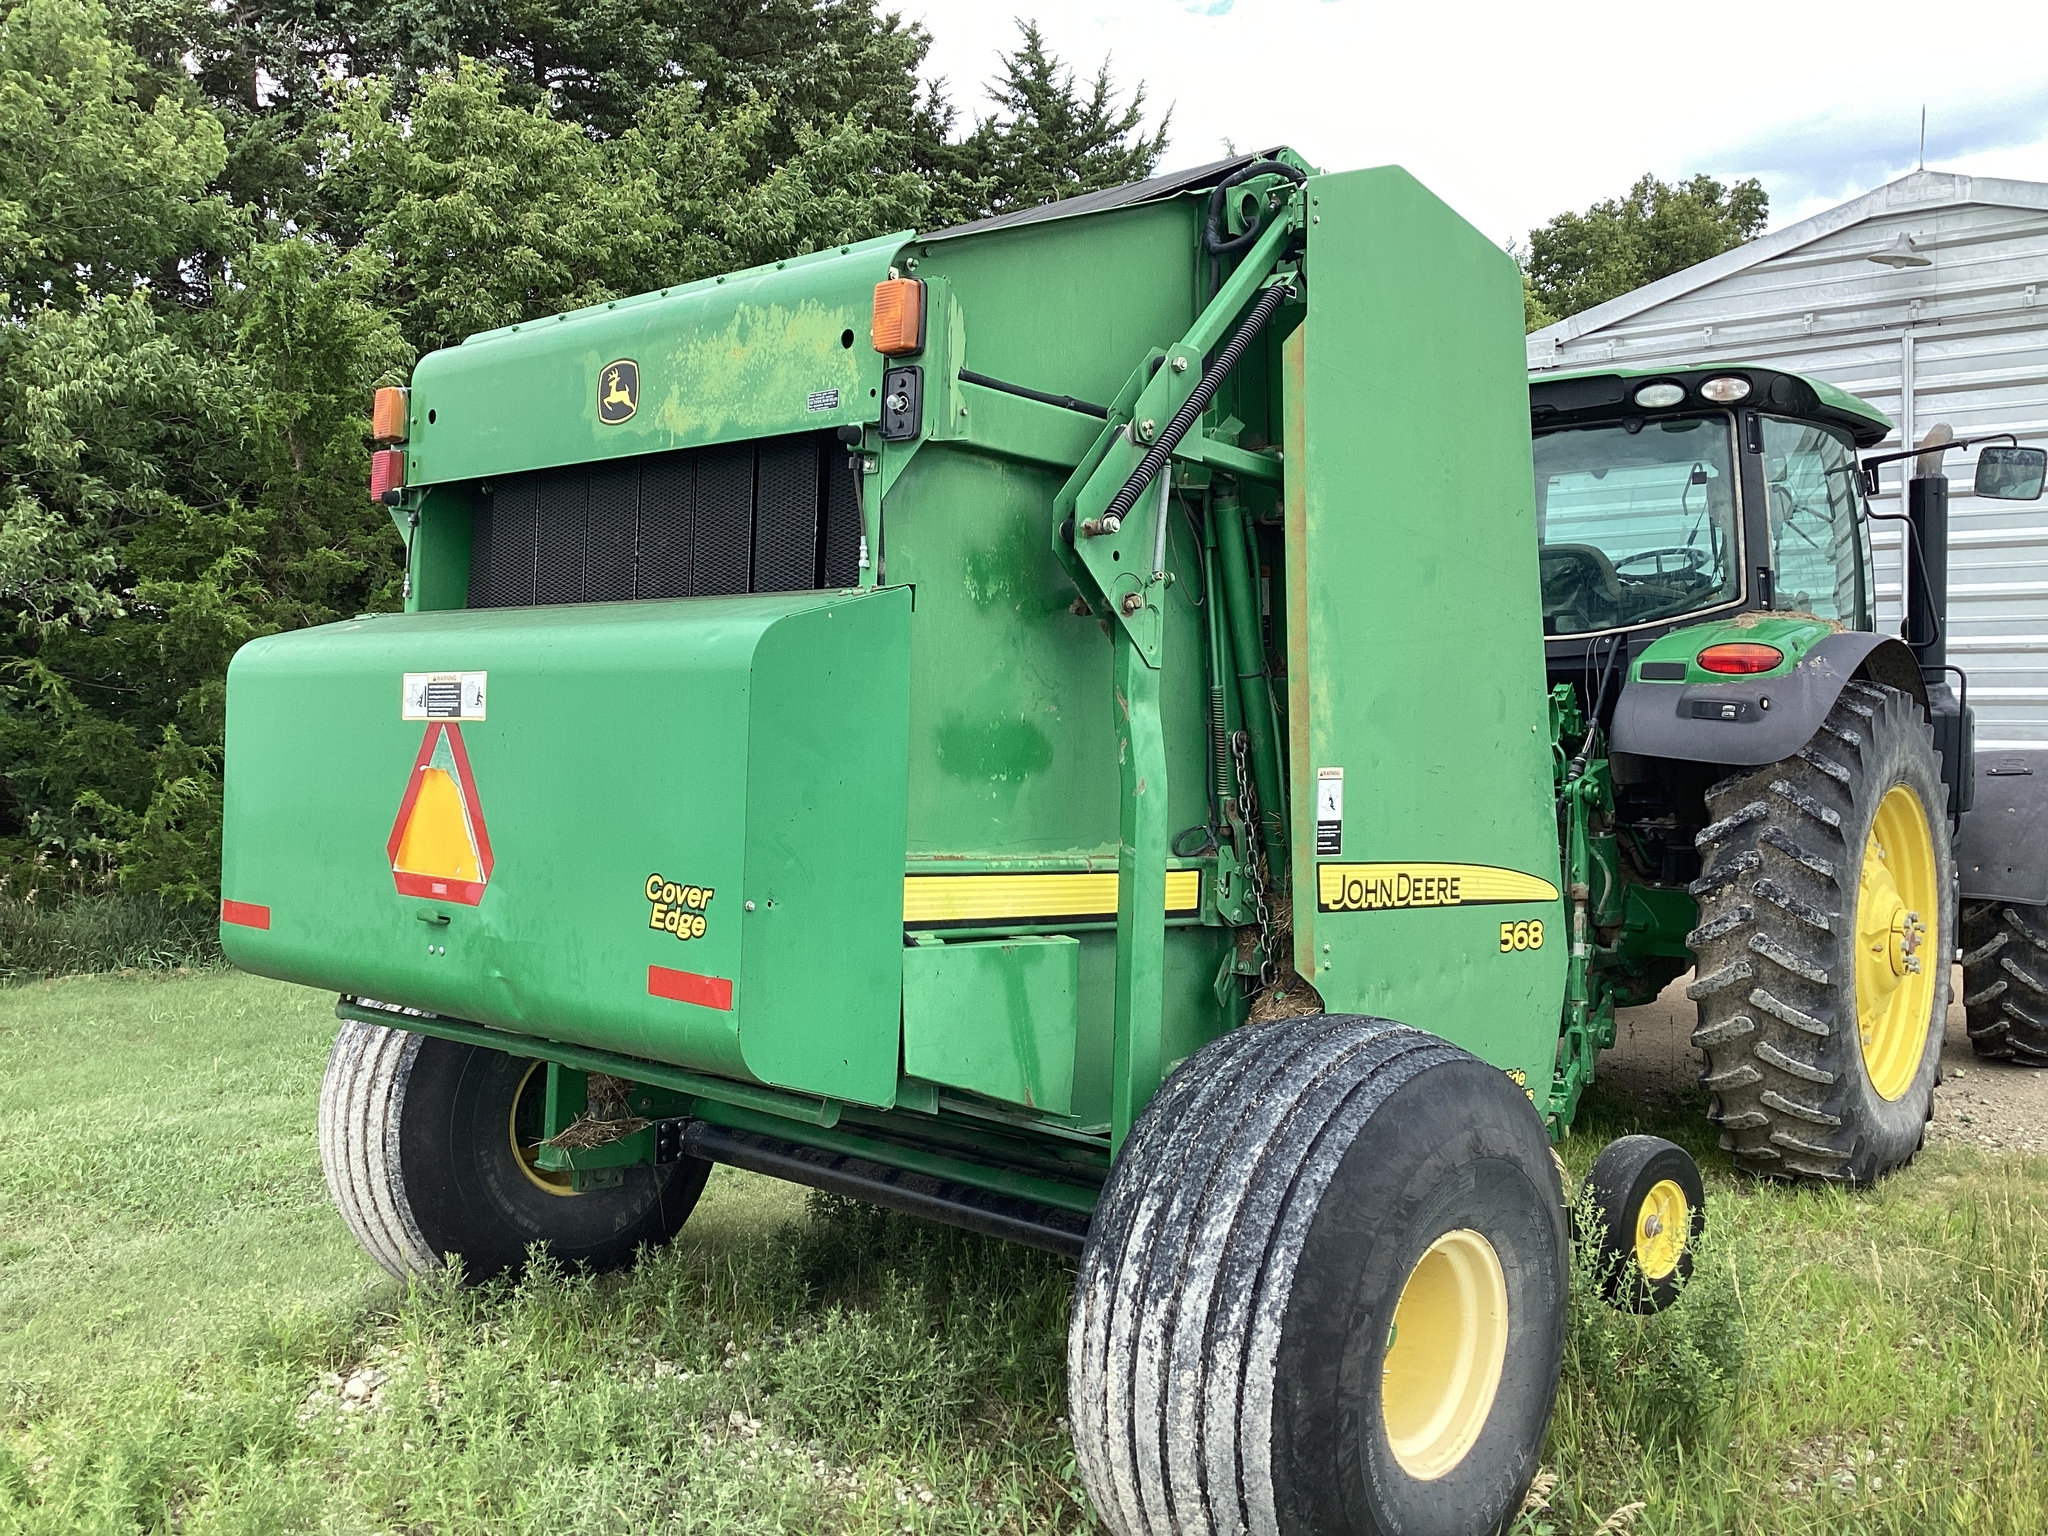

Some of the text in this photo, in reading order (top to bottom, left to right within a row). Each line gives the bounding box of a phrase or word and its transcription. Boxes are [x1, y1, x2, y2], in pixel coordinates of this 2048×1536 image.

[646, 873, 714, 911] Cover
[1331, 873, 1461, 909] JOHN DEERE
[649, 902, 707, 940] Edge
[1500, 919, 1544, 953] 568
